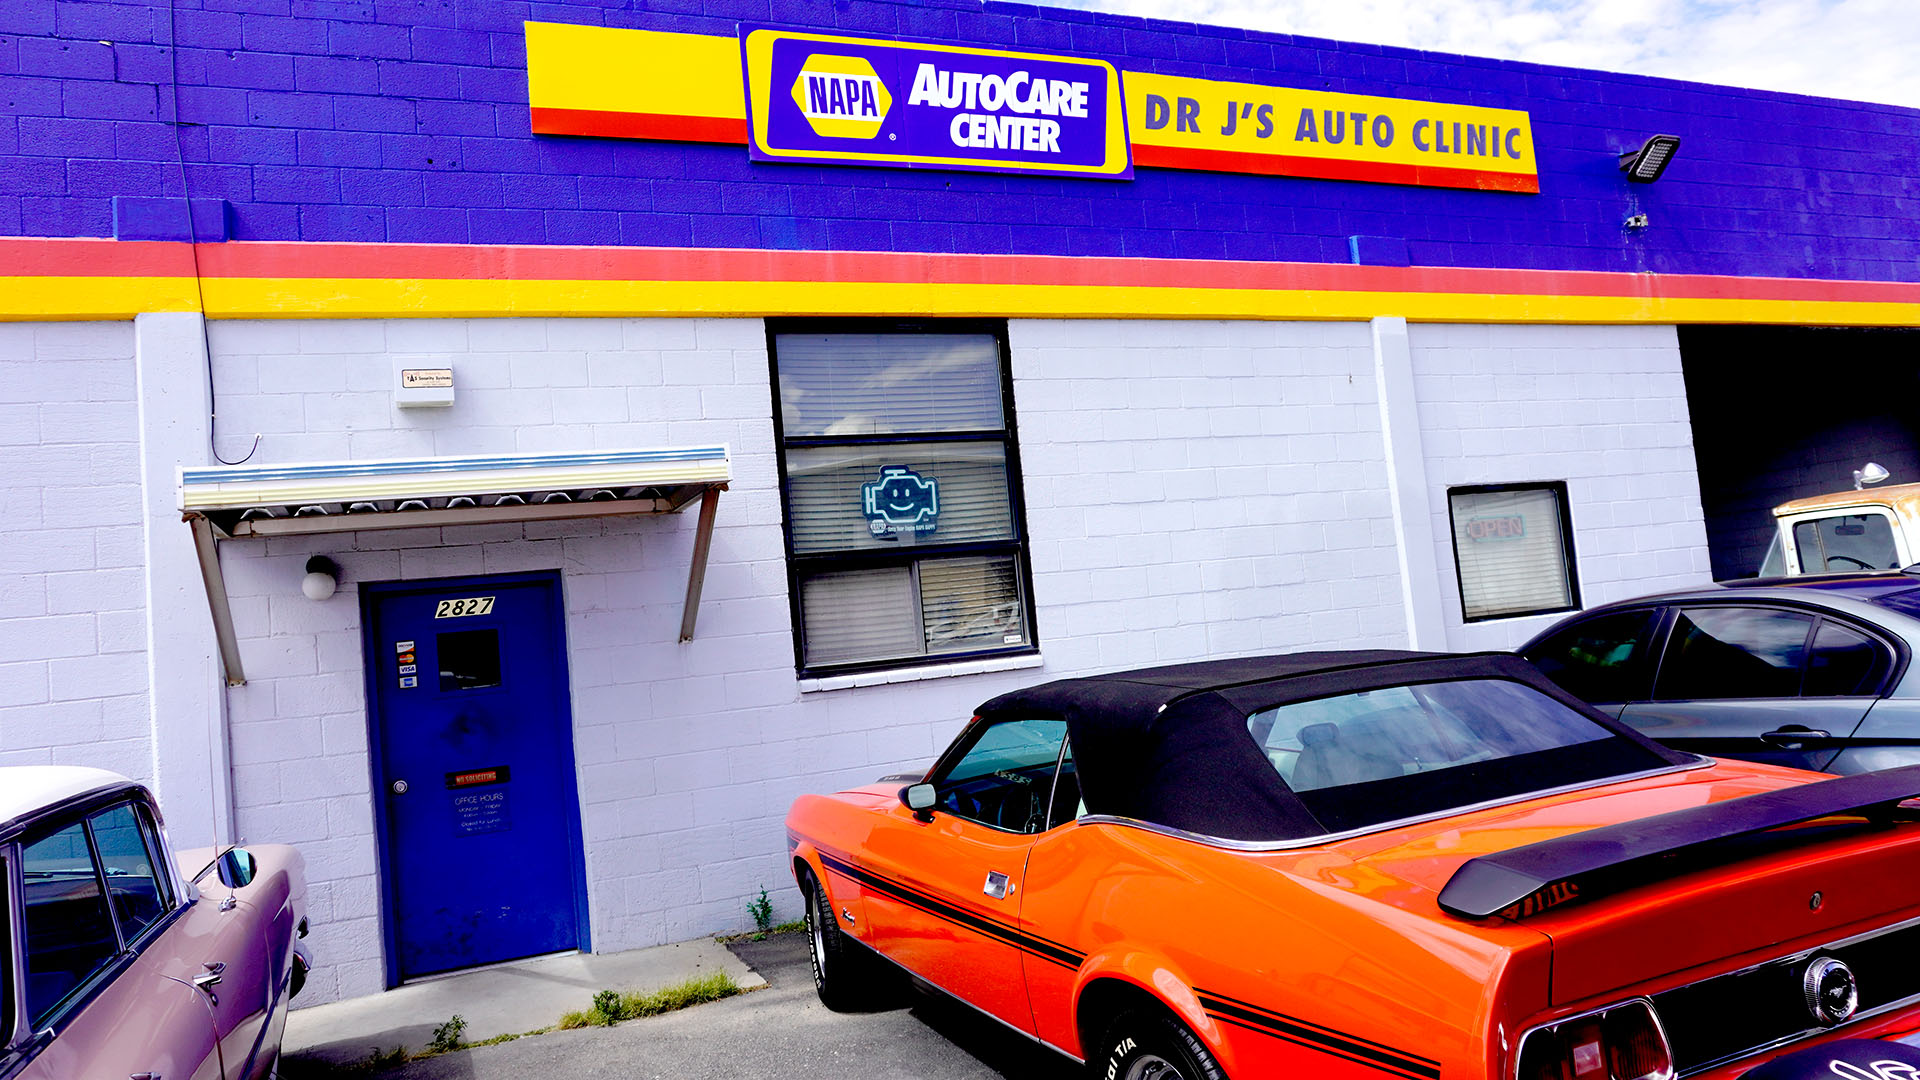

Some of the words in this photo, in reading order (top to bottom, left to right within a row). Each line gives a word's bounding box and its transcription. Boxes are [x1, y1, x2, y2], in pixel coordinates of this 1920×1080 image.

[809, 76, 878, 117] NAPA
[950, 113, 1061, 153] CENTER
[1145, 93, 1201, 133] DR
[1221, 101, 1274, 139] J'S
[1294, 108, 1395, 148] AUTO
[1412, 119, 1521, 160] CLINIC
[1469, 517, 1524, 539] OPEN
[437, 597, 494, 618] 2827
[401, 665, 415, 673] VISA
[455, 796, 478, 806] OFFICE
[480, 792, 504, 802] HOURS
[1114, 1037, 1137, 1058] T/A
